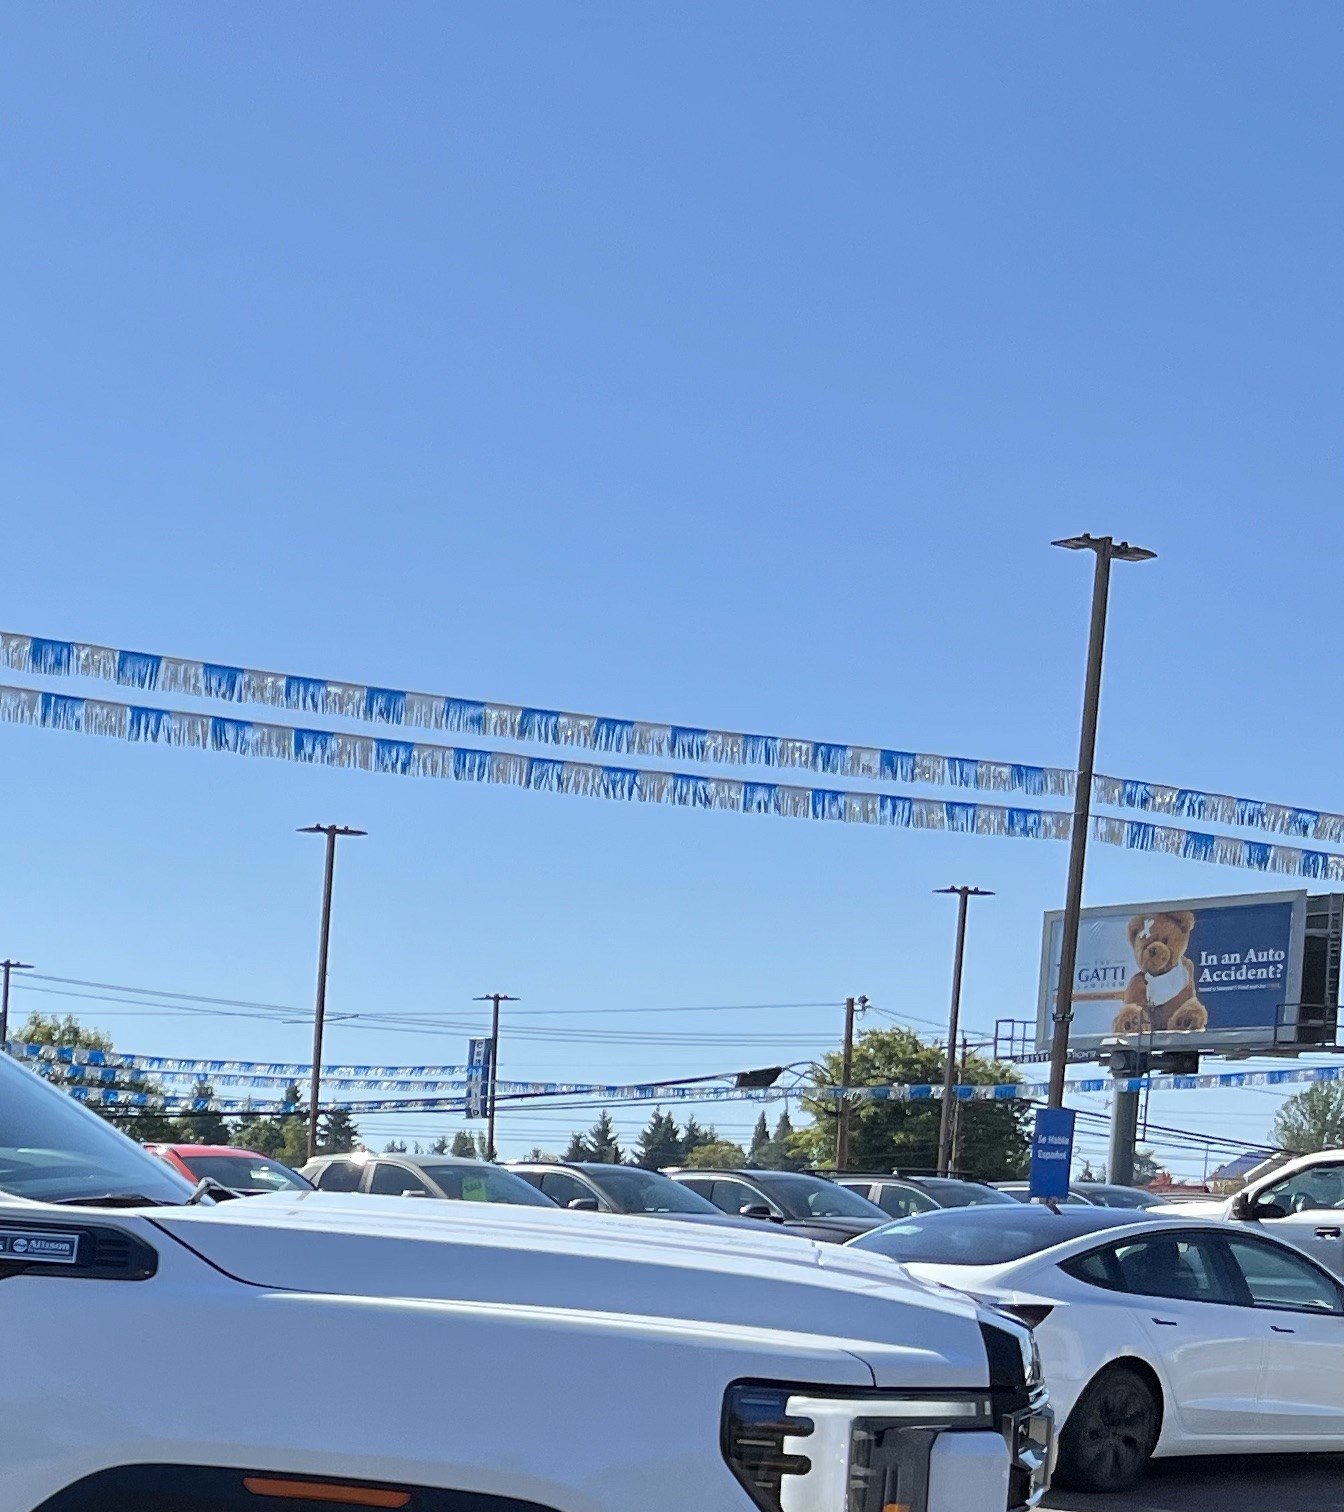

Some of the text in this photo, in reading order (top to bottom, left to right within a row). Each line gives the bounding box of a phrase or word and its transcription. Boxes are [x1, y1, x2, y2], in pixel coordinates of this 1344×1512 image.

[1200, 948, 1285, 966] In an Auto
[1078, 966, 1125, 982] GATTI
[1198, 964, 1283, 982] Accident?
[29, 1239, 70, 1251] Allison
